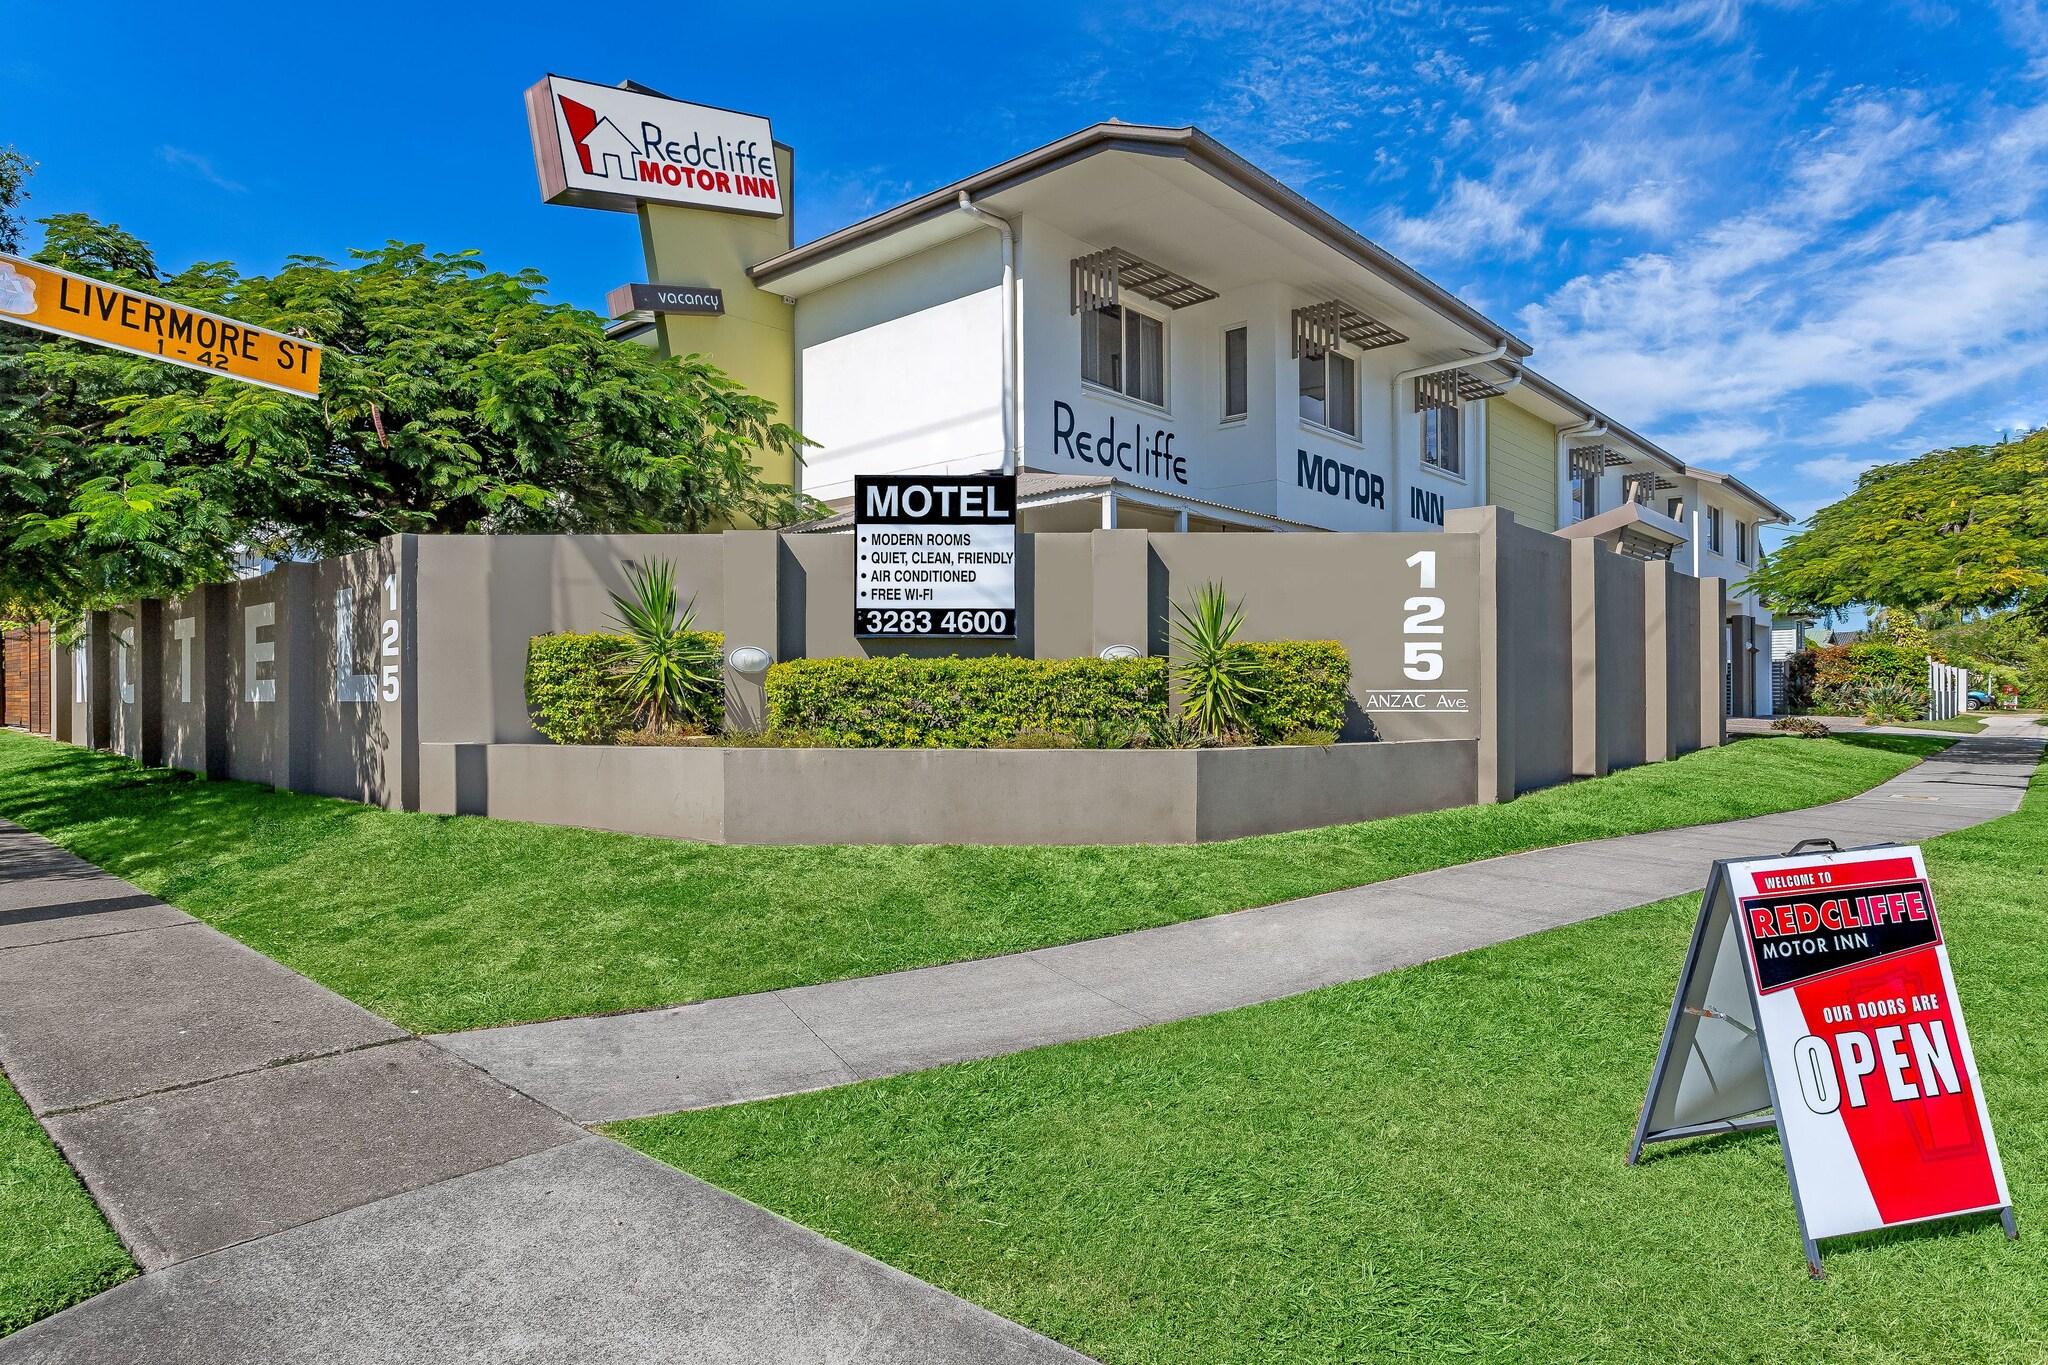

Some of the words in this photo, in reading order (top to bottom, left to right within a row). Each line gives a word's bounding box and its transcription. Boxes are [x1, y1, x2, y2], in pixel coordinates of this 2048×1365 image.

[642, 121, 772, 177] Redcliffe
[639, 161, 731, 193] MOTOR
[736, 175, 776, 199] INN
[657, 291, 719, 310] vacancy
[60, 277, 260, 362] LIVERMORE
[277, 340, 313, 374] ST
[197, 352, 229, 370] 42
[1053, 400, 1188, 485] Redcliffe
[866, 484, 1010, 518] MOTEL
[1297, 448, 1385, 510] MOTOR
[1410, 486, 1445, 527] INN
[871, 533, 923, 546] MODERN
[926, 533, 971, 546] ROOMS
[871, 551, 908, 566] QUIET,
[911, 551, 954, 566] CLEAN,
[957, 551, 1014, 565] FRIENDLY
[871, 570, 891, 582] AIR
[894, 570, 977, 583] CONDITIONED
[871, 588, 901, 601] FREE
[904, 588, 933, 601] WI-FI
[866, 610, 932, 633] 3283
[940, 610, 1007, 633] 4600
[1403, 550, 1446, 681] 125
[382, 573, 400, 703] 125
[1366, 694, 1426, 708] ANZAC
[1764, 874, 1815, 889] WELCOME
[1818, 871, 1832, 884] TO
[1750, 892, 1928, 939] REDCLIFFE
[1763, 938, 1828, 960] MOTOR
[1834, 932, 1869, 951] INN
[1822, 1006, 1853, 1024] OUR
[1858, 1000, 1907, 1019] DOORS
[1912, 994, 1939, 1013] ARE
[1793, 1020, 1963, 1114] OPEN
